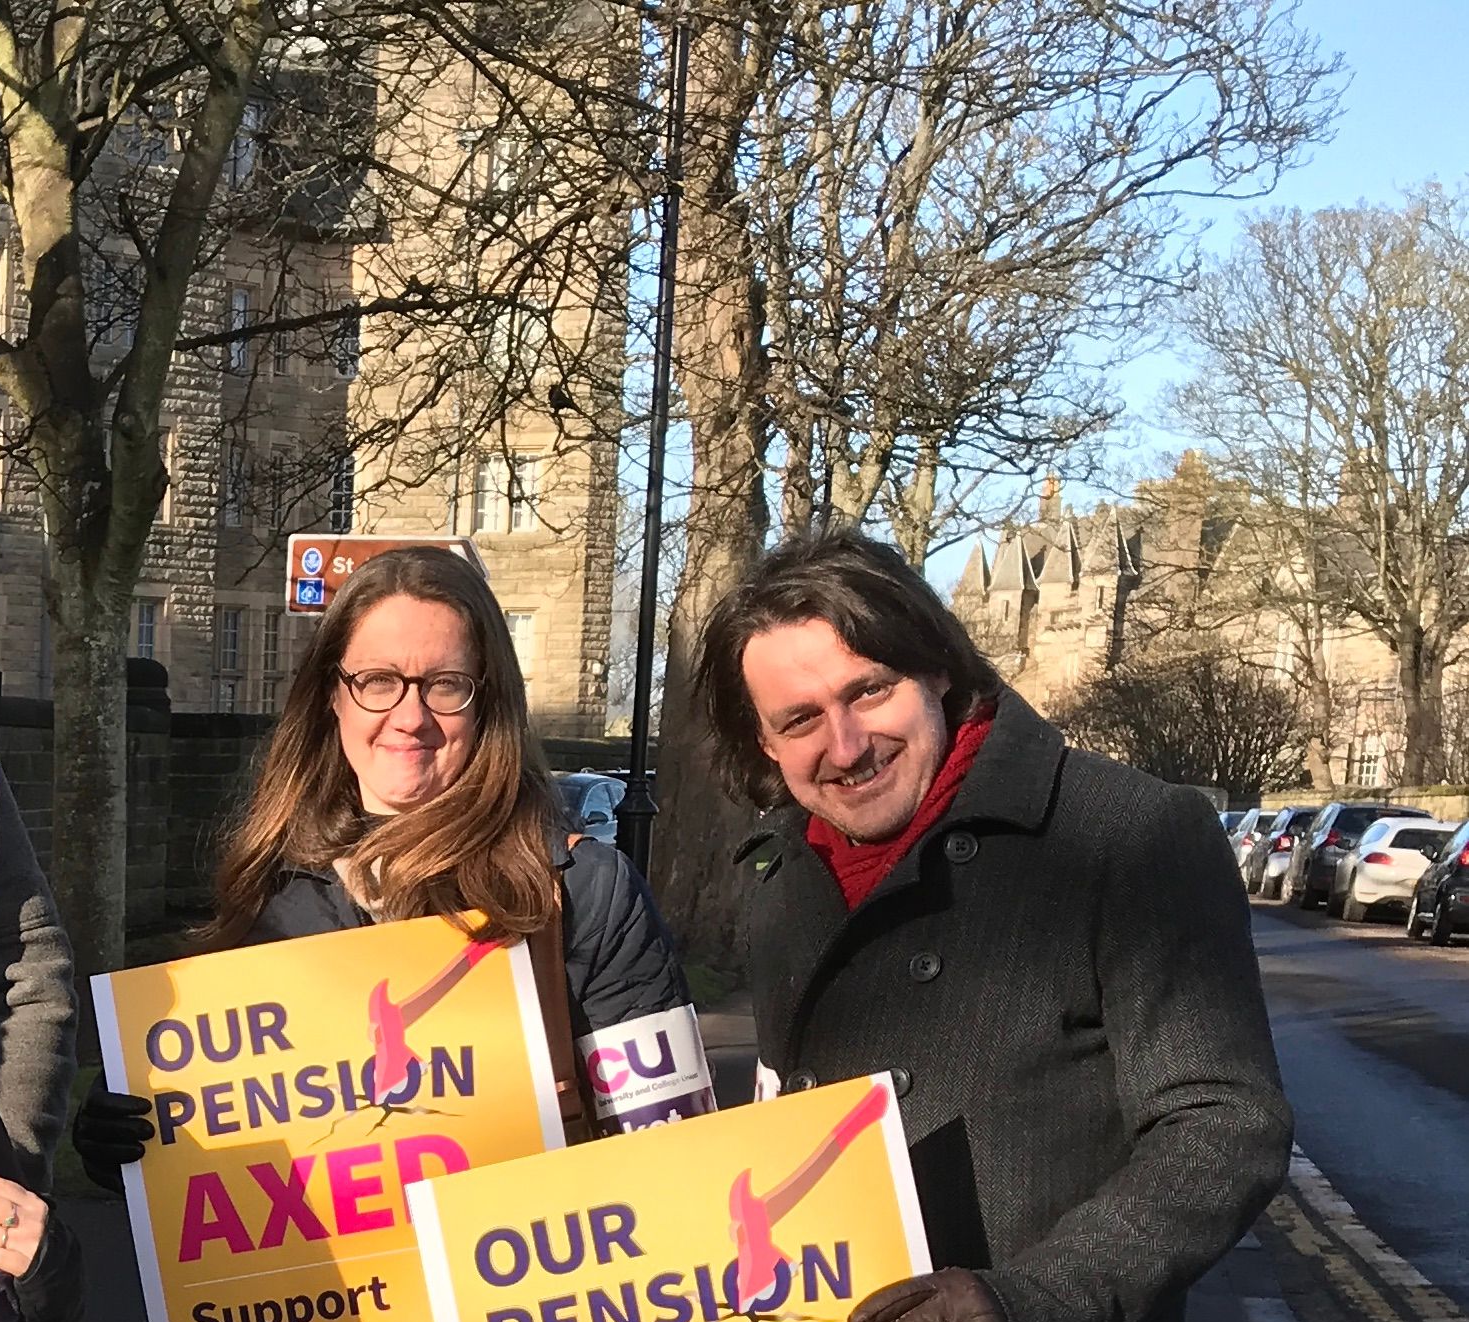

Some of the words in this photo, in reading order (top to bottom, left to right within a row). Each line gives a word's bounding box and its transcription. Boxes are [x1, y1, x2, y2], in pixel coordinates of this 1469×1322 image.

[332, 556, 355, 574] St
[145, 1001, 295, 1073] OUR
[154, 1046, 475, 1145] PENSION
[635, 1085, 651, 1096] and
[474, 1201, 647, 1288] OUR
